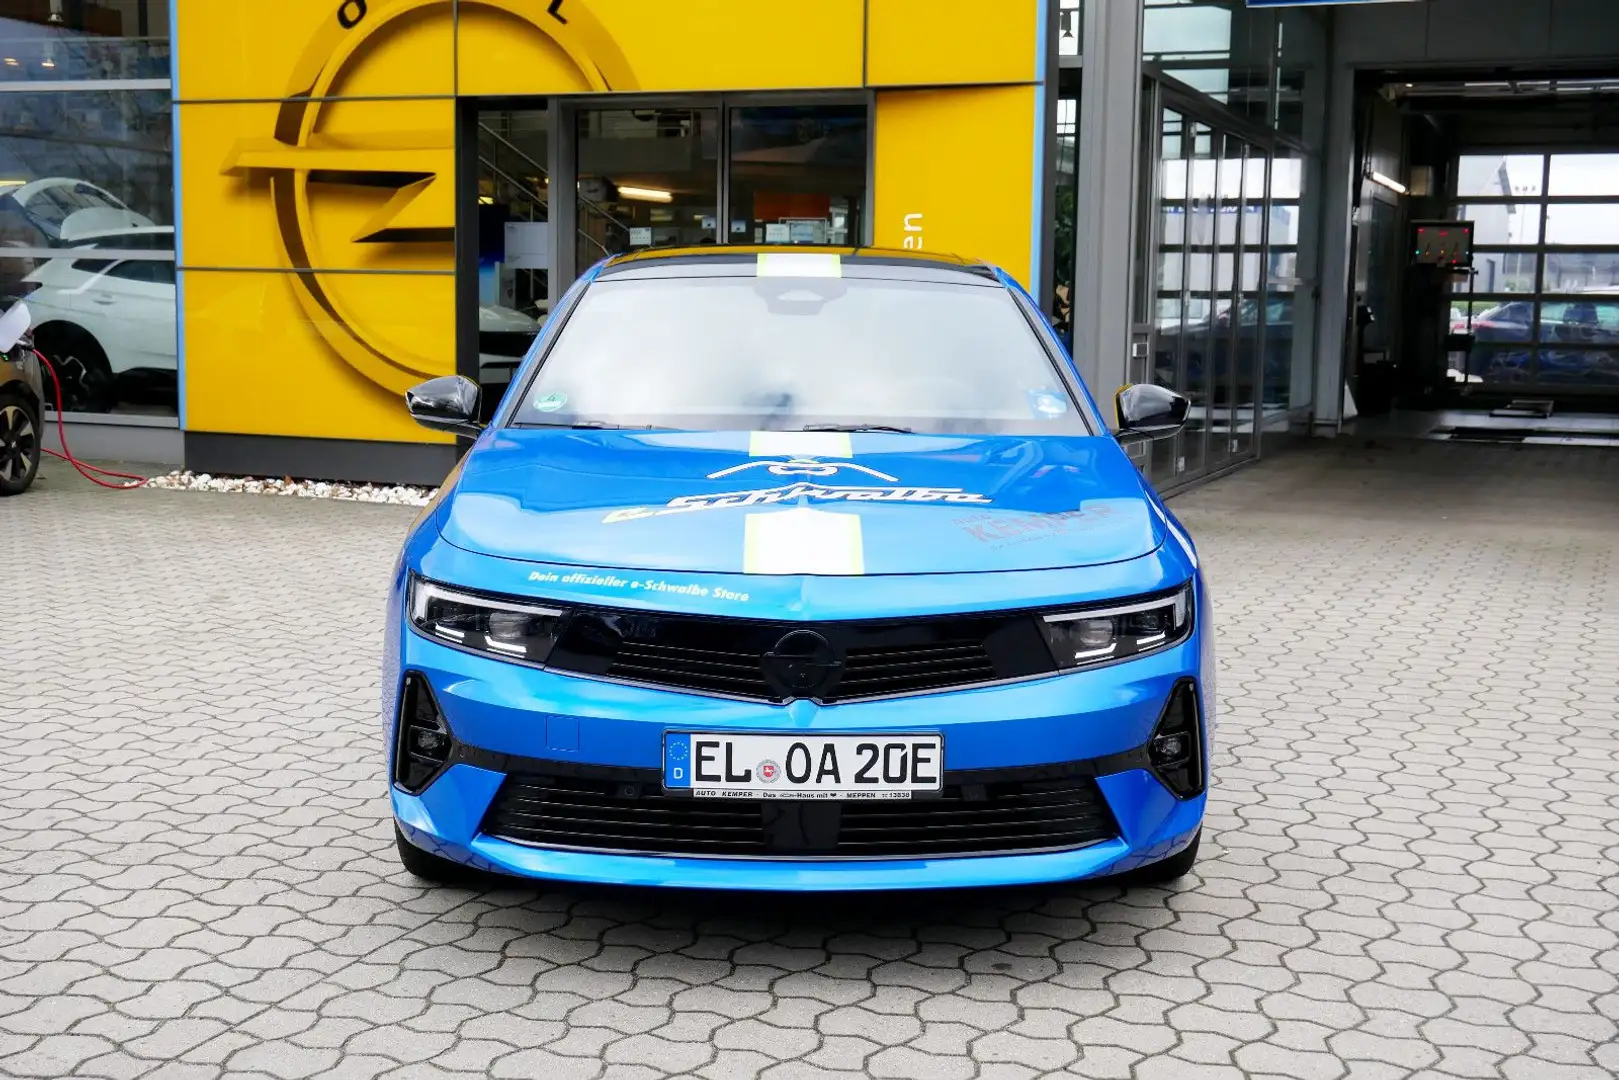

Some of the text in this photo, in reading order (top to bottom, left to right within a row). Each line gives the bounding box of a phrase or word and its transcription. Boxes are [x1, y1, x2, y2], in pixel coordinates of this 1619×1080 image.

[528, 571, 749, 602] Dein offizieller e-Schwalbe Store
[673, 767, 683, 779] D
[695, 741, 751, 782] EL
[785, 742, 841, 784] OA
[854, 743, 937, 784] 20E
